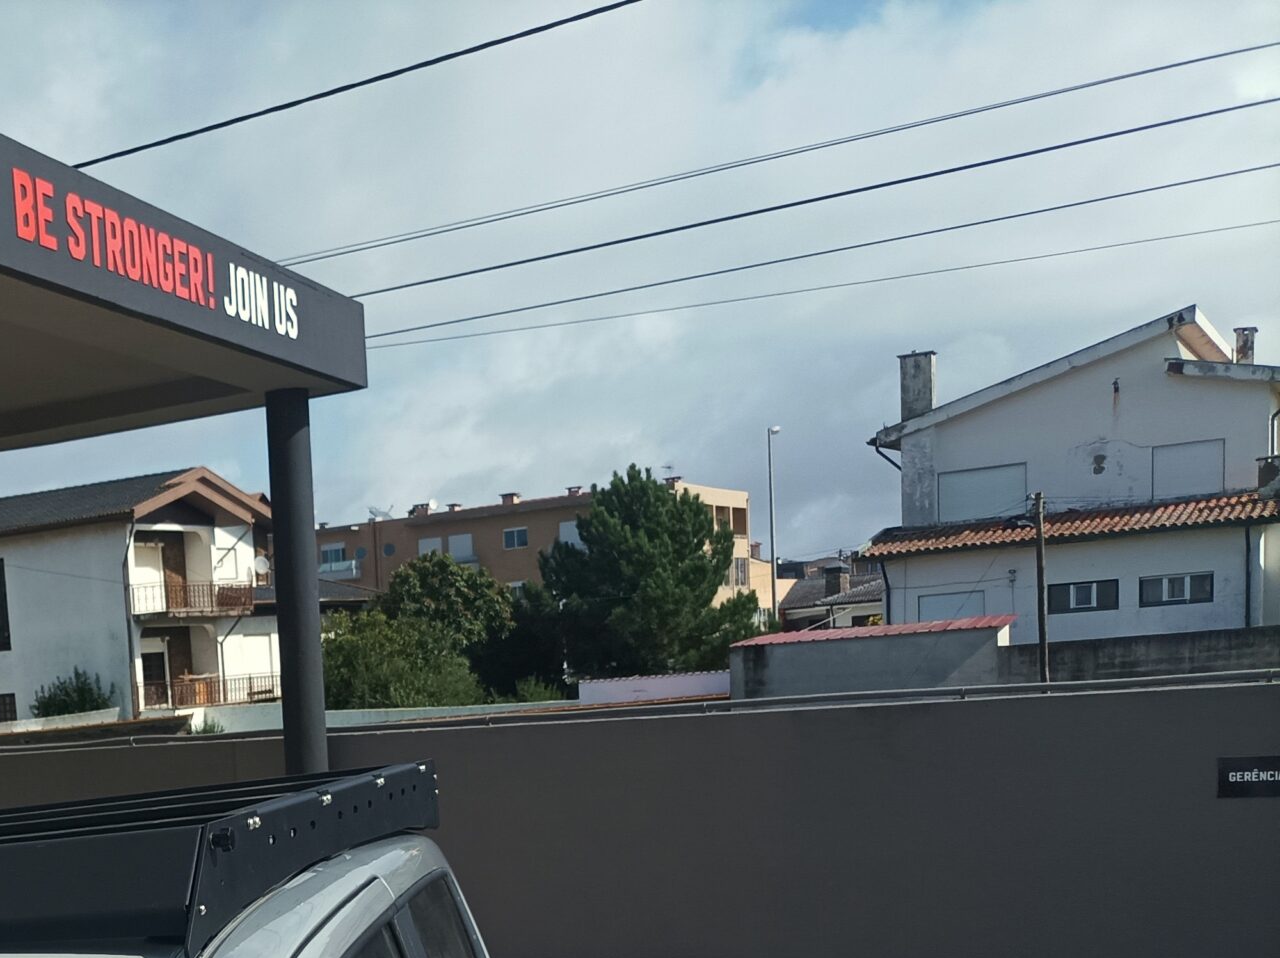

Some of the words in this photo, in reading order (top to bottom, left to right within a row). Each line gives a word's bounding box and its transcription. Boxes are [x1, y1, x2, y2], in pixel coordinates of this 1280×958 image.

[12, 167, 58, 251] BE
[65, 192, 217, 311] STRONGER!
[223, 262, 270, 330] JOIN
[273, 281, 299, 340] US
[1228, 768, 1280, 782] GERÊNCI
